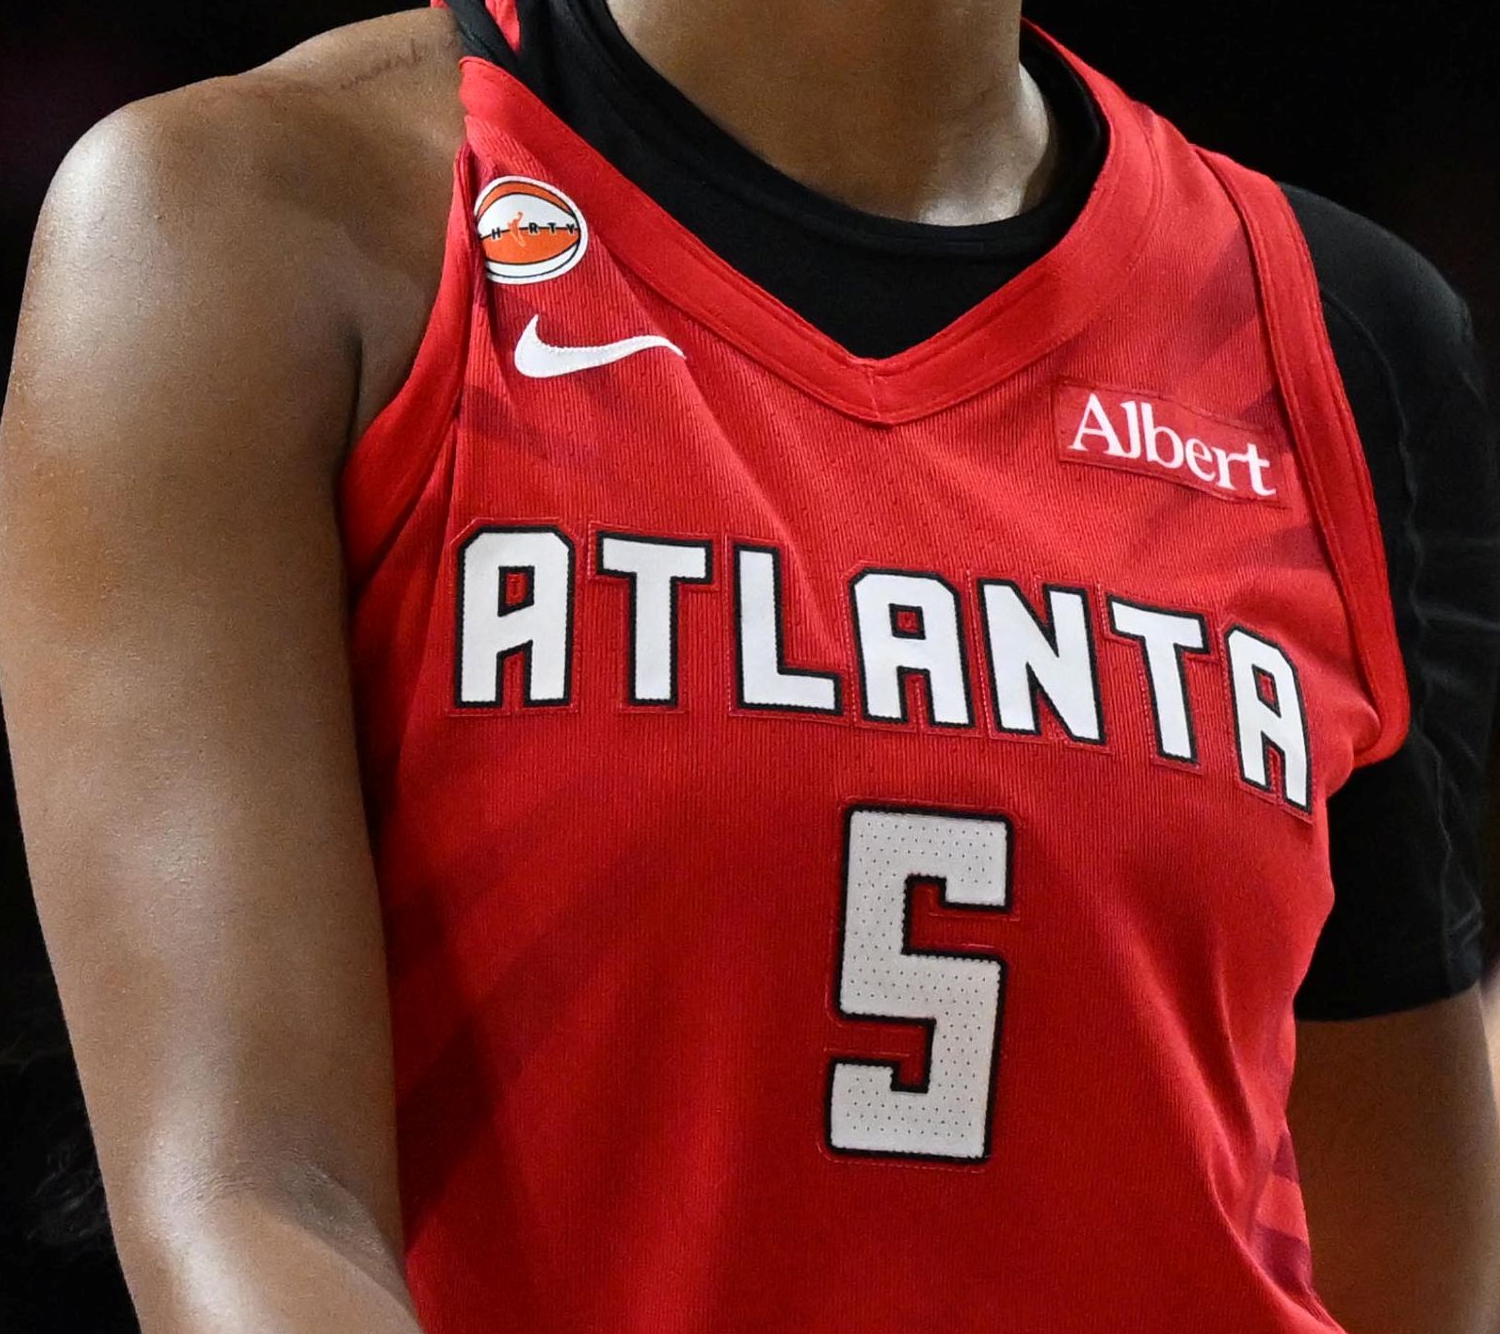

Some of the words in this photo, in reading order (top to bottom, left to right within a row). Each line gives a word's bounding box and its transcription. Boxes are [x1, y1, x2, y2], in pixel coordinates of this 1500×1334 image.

[1067, 392, 1278, 498] Albert
[456, 521, 1313, 813] ATLANTA
[824, 804, 1014, 1160] 5
